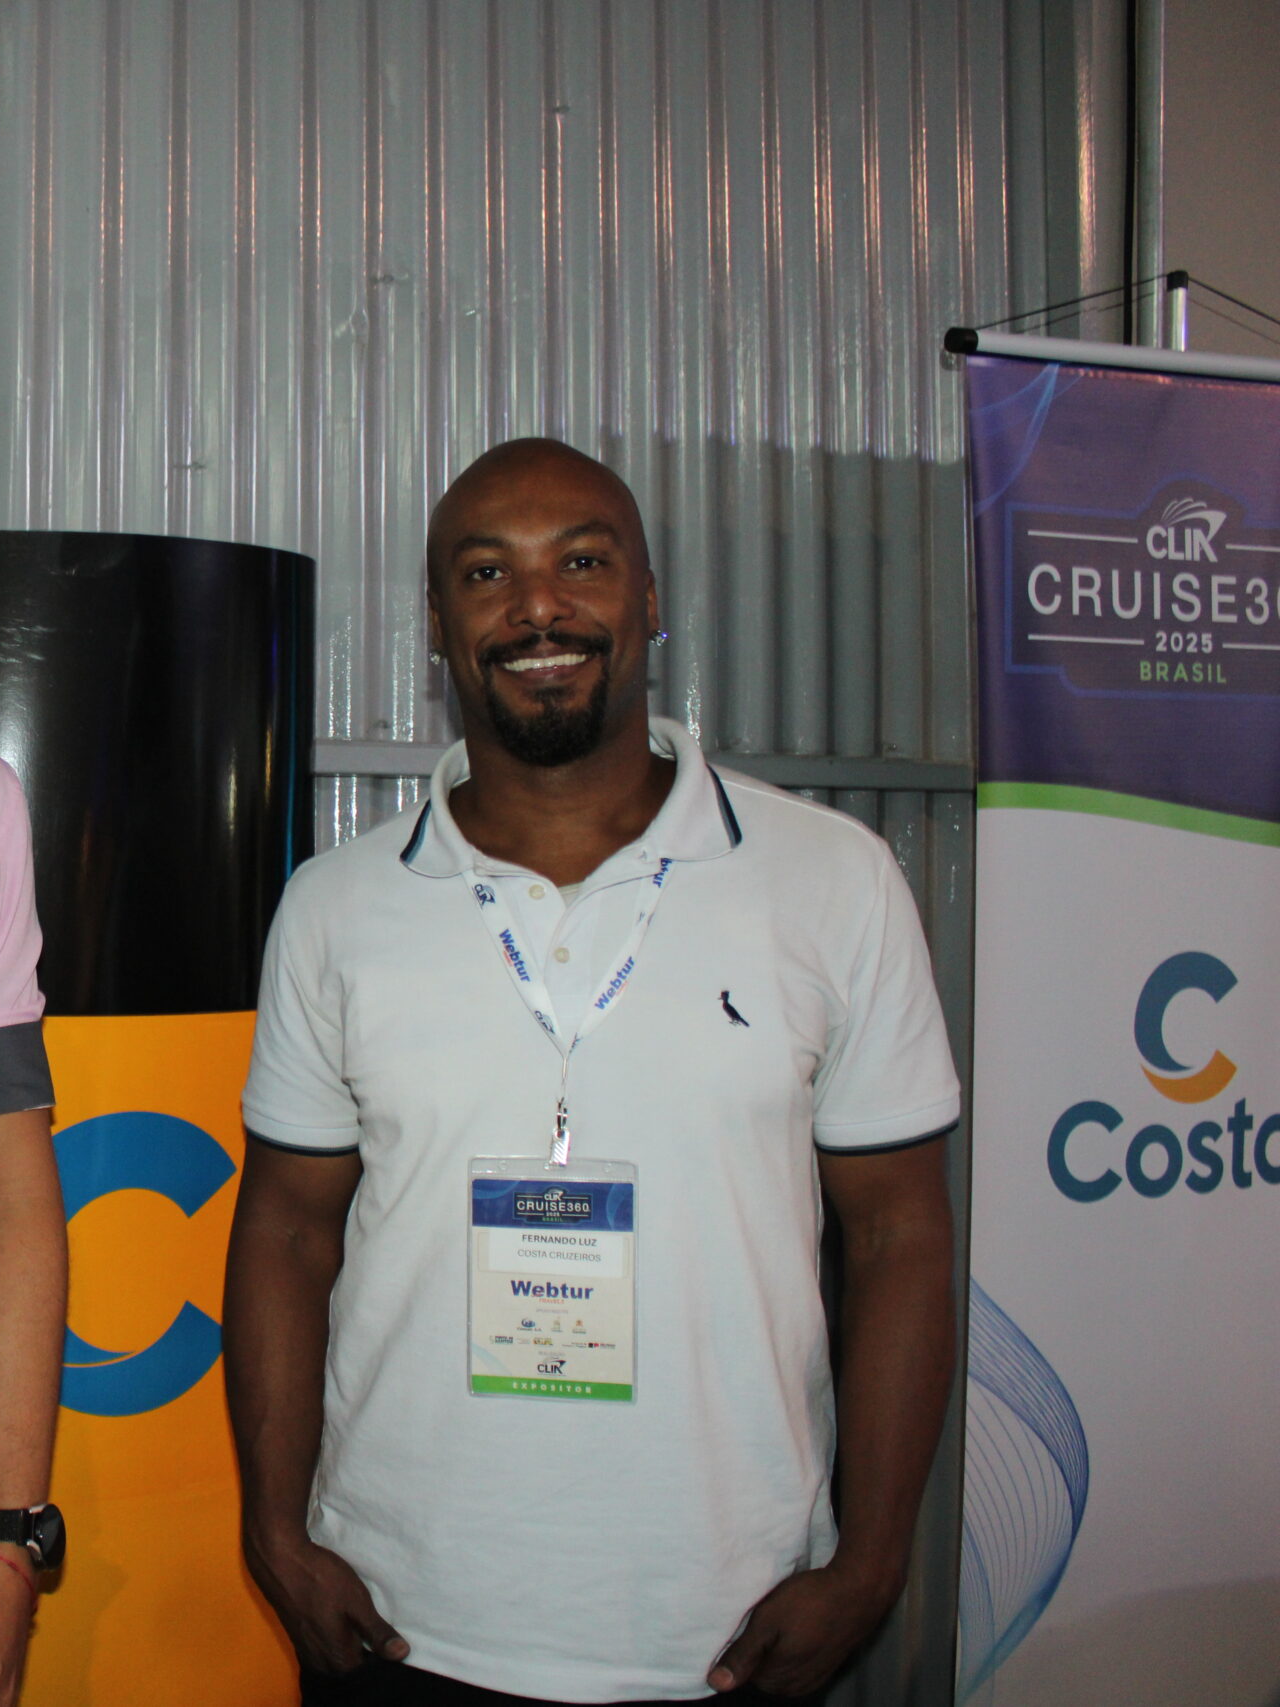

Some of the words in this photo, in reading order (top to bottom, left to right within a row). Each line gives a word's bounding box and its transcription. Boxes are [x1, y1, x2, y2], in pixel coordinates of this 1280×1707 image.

[1028, 563, 1280, 625] CRUISE3
[1155, 630, 1213, 653] 2025
[1140, 660, 1227, 683] BRASIL
[499, 928, 531, 983] Webtur
[594, 956, 636, 1010] Webtur
[516, 1200, 589, 1212] CRUISE360
[522, 1234, 577, 1246] FERNANDO
[579, 1238, 597, 1247] LUZ
[517, 1249, 547, 1259] COSTA
[549, 1251, 601, 1262] CRUZEIROS
[511, 1280, 594, 1300] Webtur
[513, 1382, 592, 1394] EXPOSITOR
